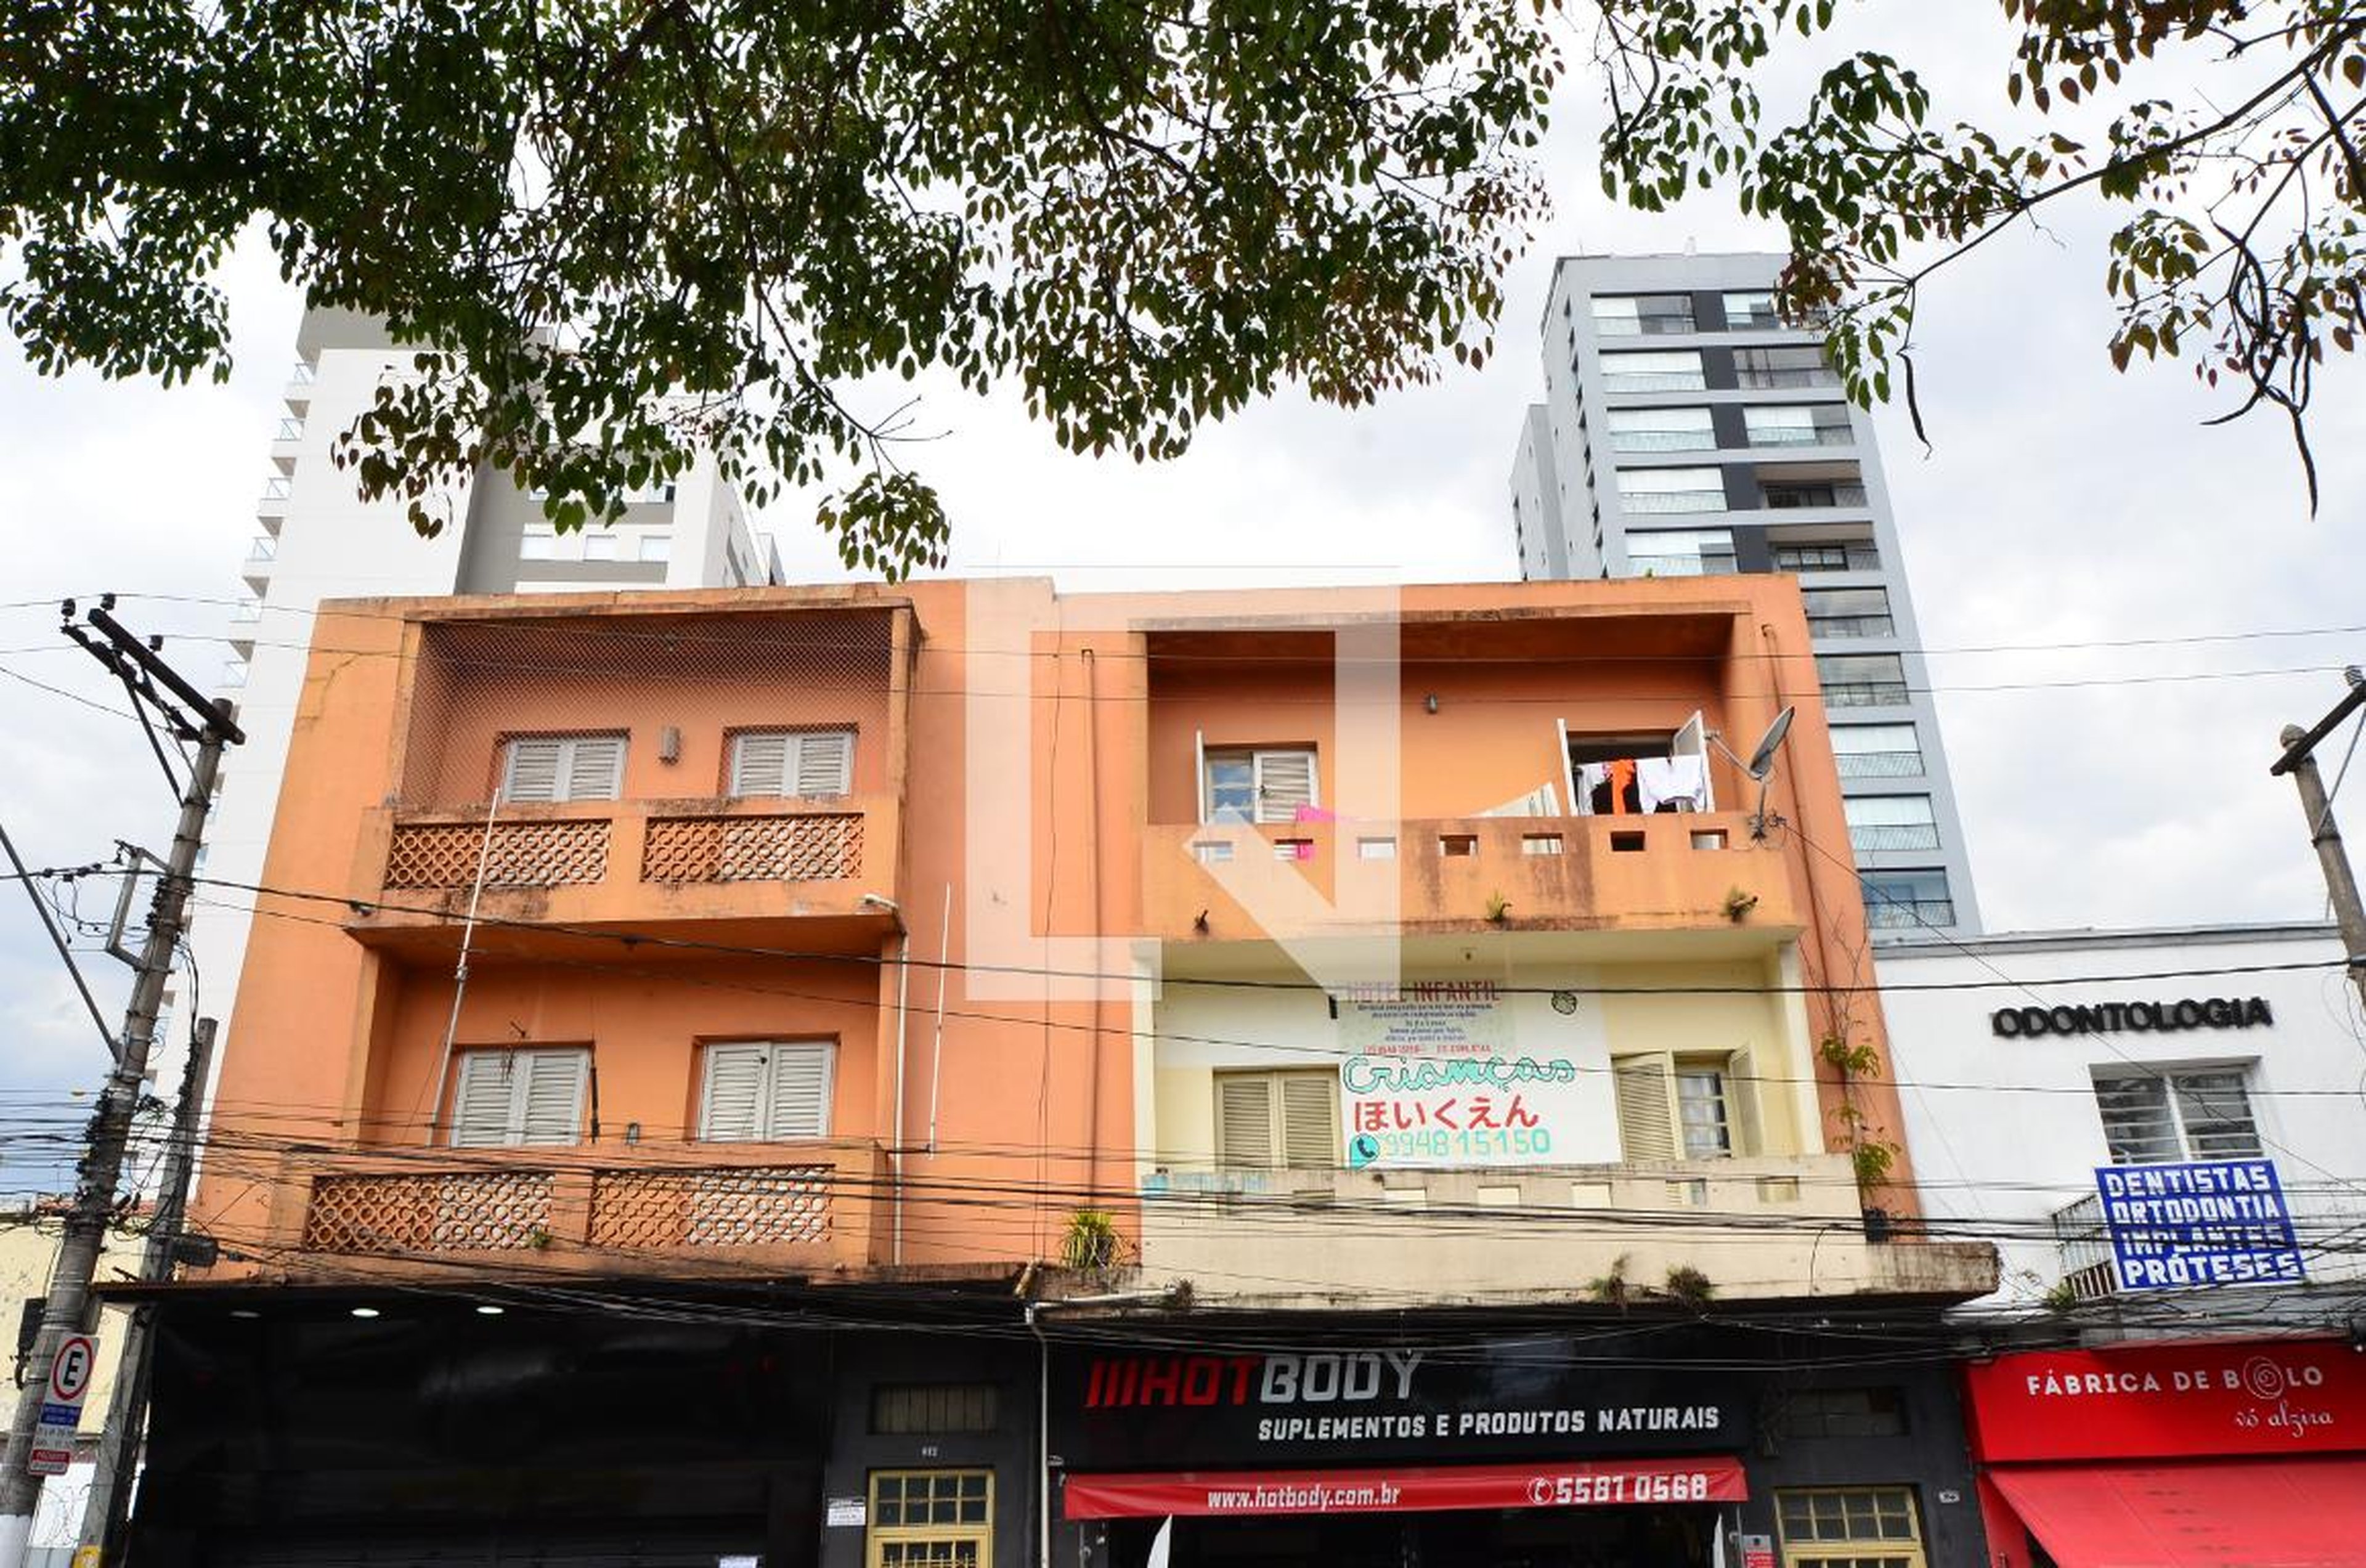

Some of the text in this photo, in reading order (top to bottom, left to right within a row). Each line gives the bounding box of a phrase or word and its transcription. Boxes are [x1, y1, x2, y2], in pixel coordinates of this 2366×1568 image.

[1414, 979, 1501, 1002] INFANTIL
[1993, 997, 2273, 1038] ODONTOLOGIA
[1343, 1056, 1575, 1094] Crianças
[1354, 1094, 1539, 1132] ほいくえん
[2105, 1166, 2271, 1197] DENTISTAS
[2111, 1194, 2280, 1224] ORTODONTIA
[2121, 1223, 2285, 1255] IMPLANTES
[2123, 1253, 2300, 1285] PRÓTESES
[63, 1351, 84, 1387] E
[2027, 1368, 2160, 1395] FÁBRICA
[2173, 1370, 2210, 1391] DE
[1258, 1407, 1720, 1440] SUPLEMENTOS E PRODUTOS NATURAIS
[2235, 1399, 2334, 1438] vó alzira
[1207, 1482, 1402, 1511] www.hotbody.com.br
[1556, 1473, 1709, 1504] 5581 0568
